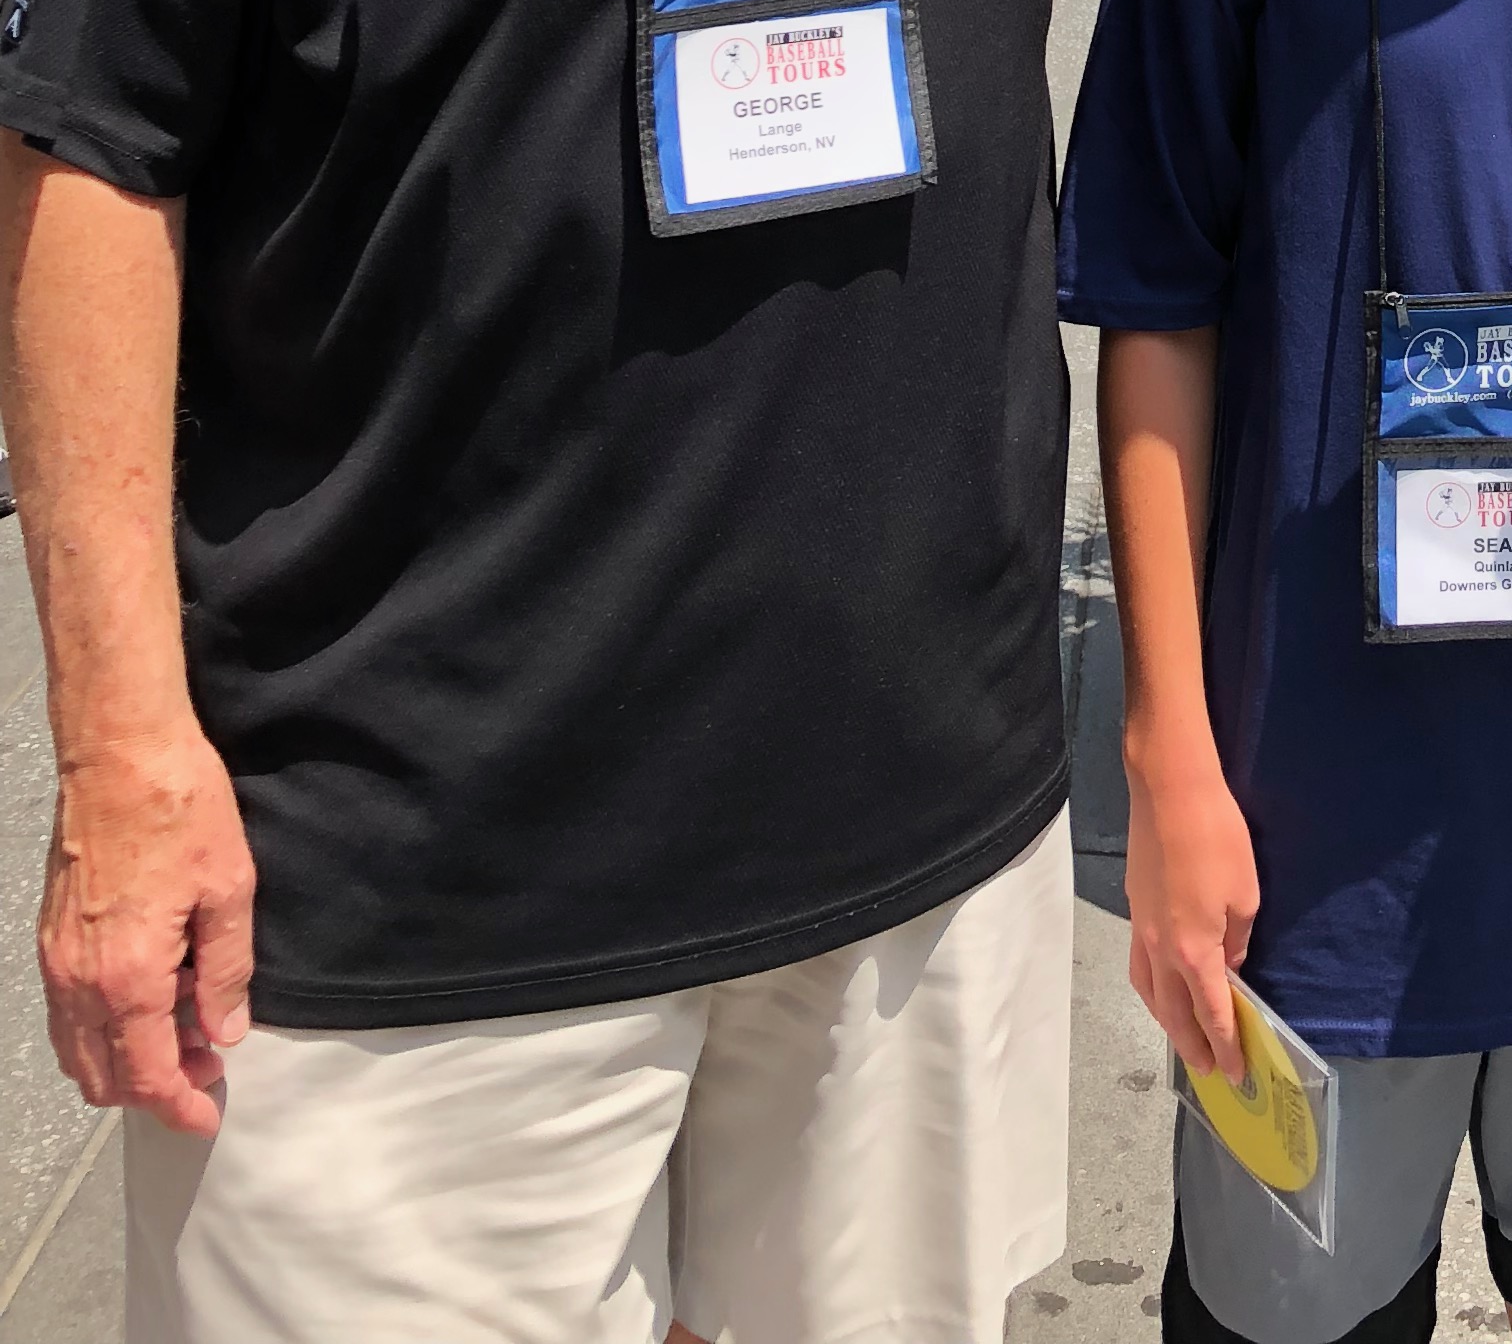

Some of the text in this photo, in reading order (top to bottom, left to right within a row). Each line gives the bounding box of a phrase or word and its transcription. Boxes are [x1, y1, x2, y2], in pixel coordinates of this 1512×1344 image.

[767, 27, 843, 46] JAY BUCKLEY'S
[767, 39, 845, 65] BASEBALL
[767, 58, 846, 85] TOURS
[734, 92, 823, 118] GEORGE
[759, 122, 802, 137] Lange
[729, 135, 836, 161] Henderson, NV
[1480, 328, 1501, 340] JAY
[1410, 391, 1497, 407] jaybuckley.com
[1480, 482, 1496, 492] JAY
[1439, 580, 1497, 592] Downers
